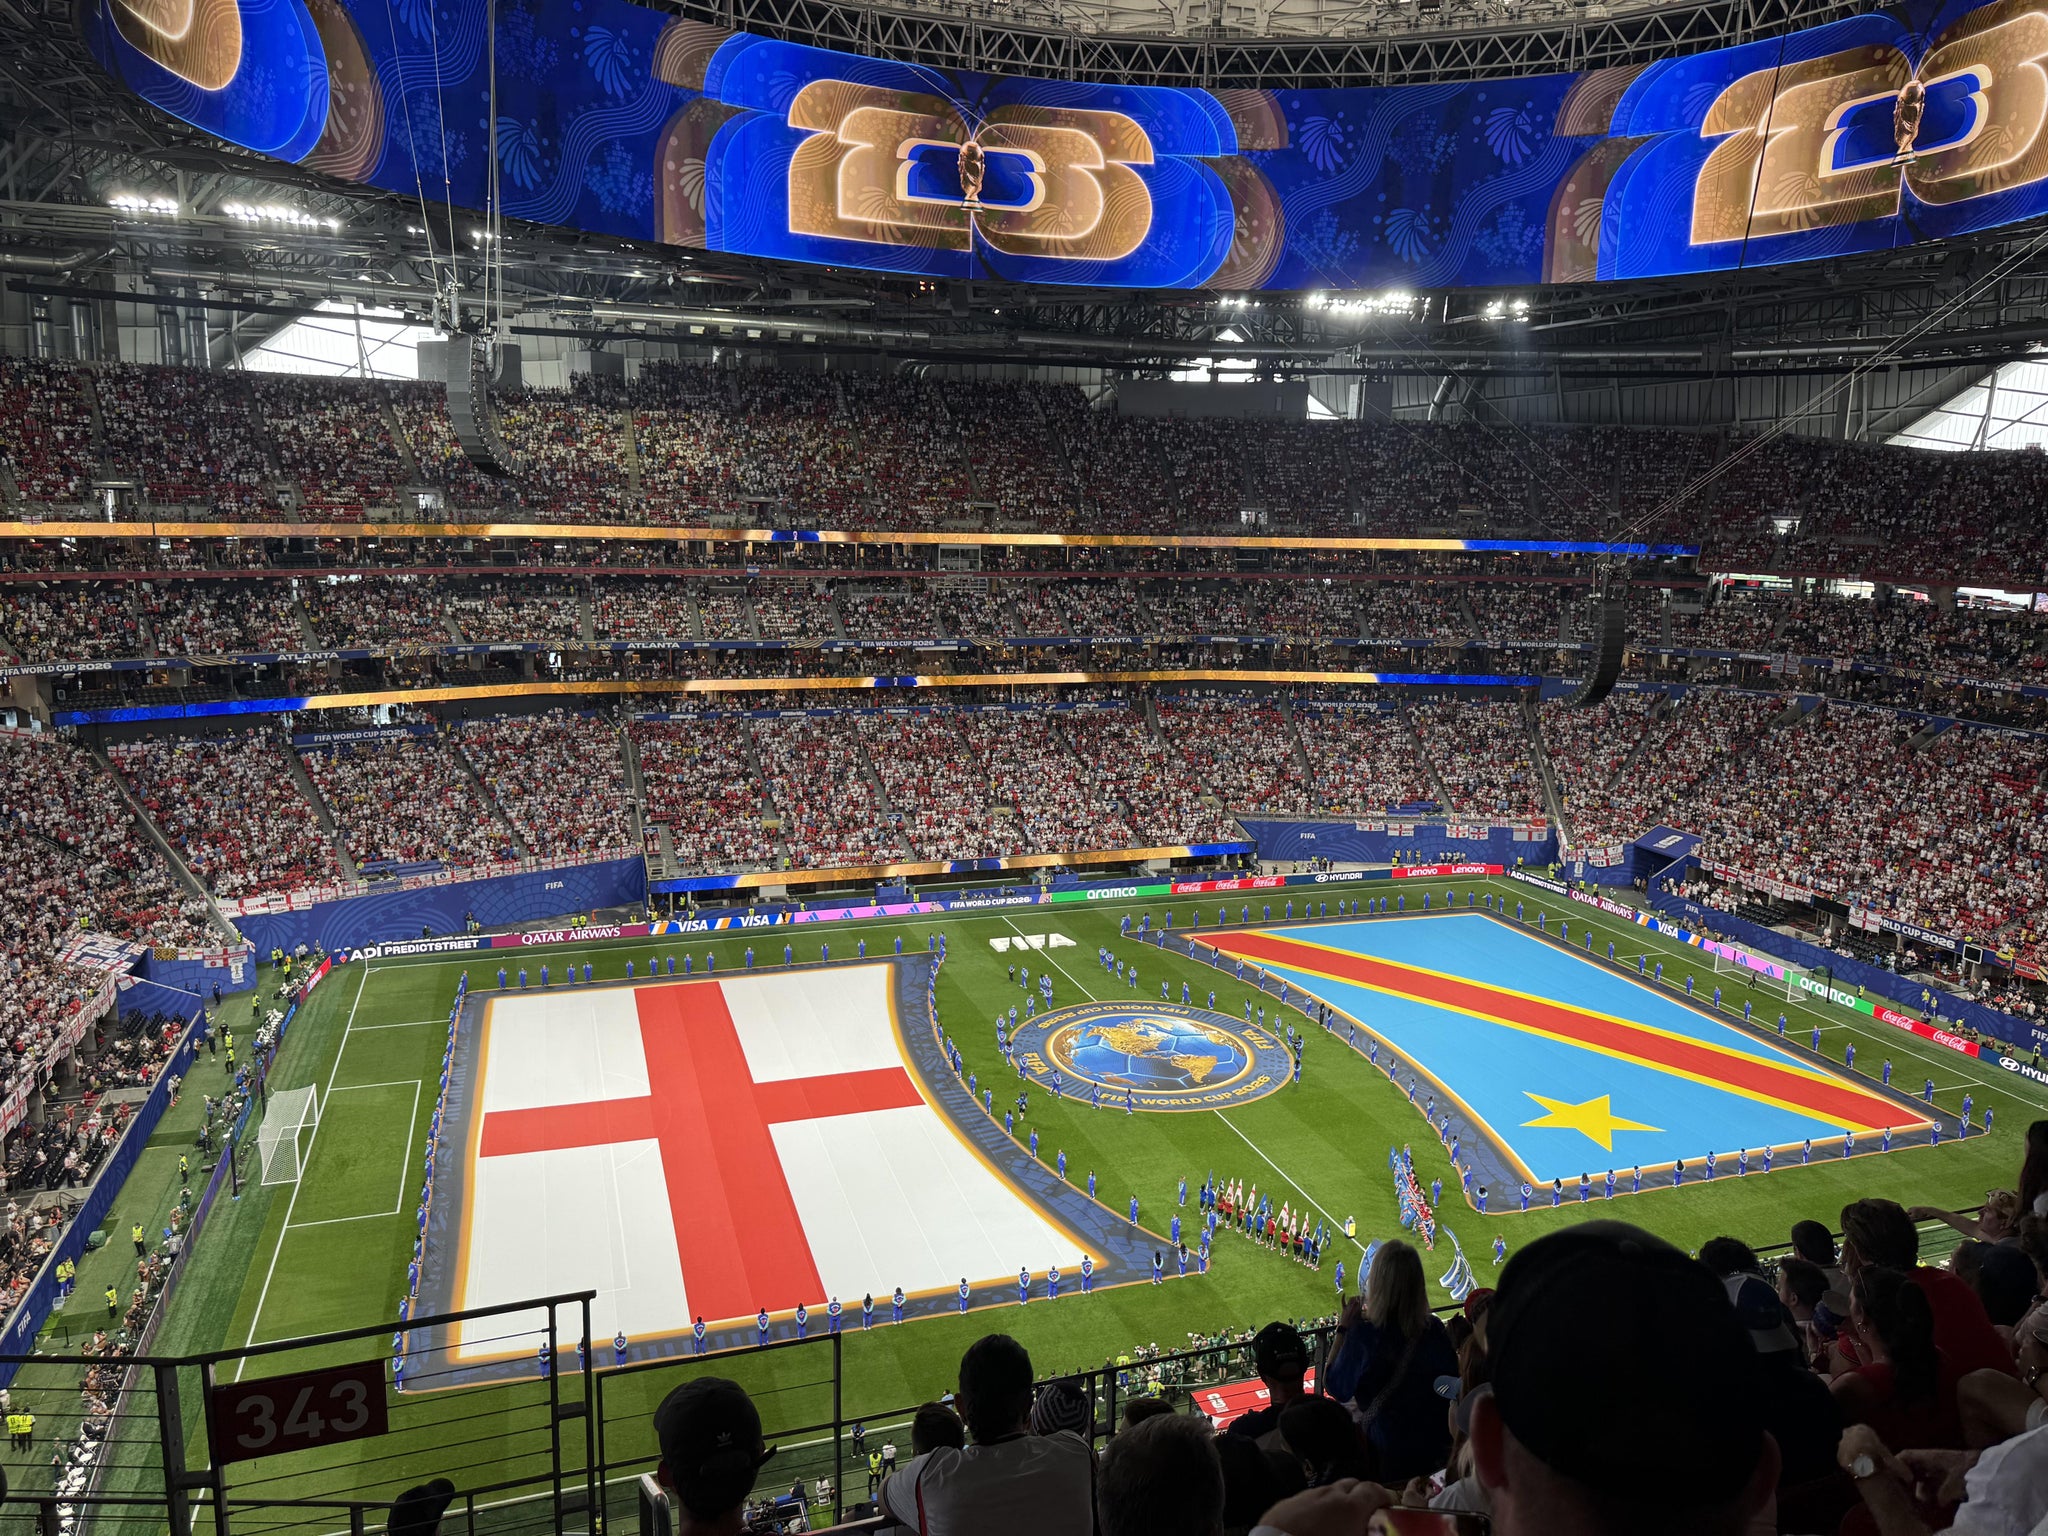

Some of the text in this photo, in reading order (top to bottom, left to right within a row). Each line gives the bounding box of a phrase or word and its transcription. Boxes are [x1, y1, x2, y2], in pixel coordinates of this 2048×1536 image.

[626, 641, 681, 649] ATLANTA
[277, 651, 339, 661] ATLANTA
[20, 665, 55, 675] WORLD
[56, 664, 76, 672] CUP
[77, 662, 112, 671] 2026
[314, 734, 332, 742] FIFA
[332, 733, 362, 741] WORLD
[363, 731, 379, 739] CUP
[1300, 832, 1316, 840] FIFA
[1407, 867, 1438, 876] Lenovo
[1451, 865, 1485, 874] Lenovo
[1510, 870, 1525, 881] ADI
[1329, 872, 1363, 881] HYUNDAI
[545, 881, 564, 890] FIFA
[1086, 886, 1138, 900] aramco
[966, 900, 991, 908] WORLD
[1006, 896, 1030, 905] 2026
[1571, 890, 1633, 919] QATAR AIRWAYS
[1685, 903, 1699, 914] FIFA
[676, 919, 708, 932] VISA
[738, 915, 770, 927] VISA
[1657, 920, 1679, 939] VISA
[1879, 917, 1901, 931] RLD
[1902, 926, 1921, 938] CUP
[1921, 932, 1956, 949] 2026
[521, 927, 621, 945] QATAR AIRWAYS
[989, 933, 1077, 952] FIFA
[350, 940, 479, 962] ADI PREDICTSTREET
[1799, 976, 1856, 1007] aramco
[1076, 1007, 1102, 1015] CUP
[1140, 1097, 1202, 1105] WORLD
[1203, 1091, 1232, 1103] CUP
[1232, 1074, 1271, 1096] 2026
[17, 1309, 32, 1339] FIFA
[235, 1379, 370, 1449] 343
